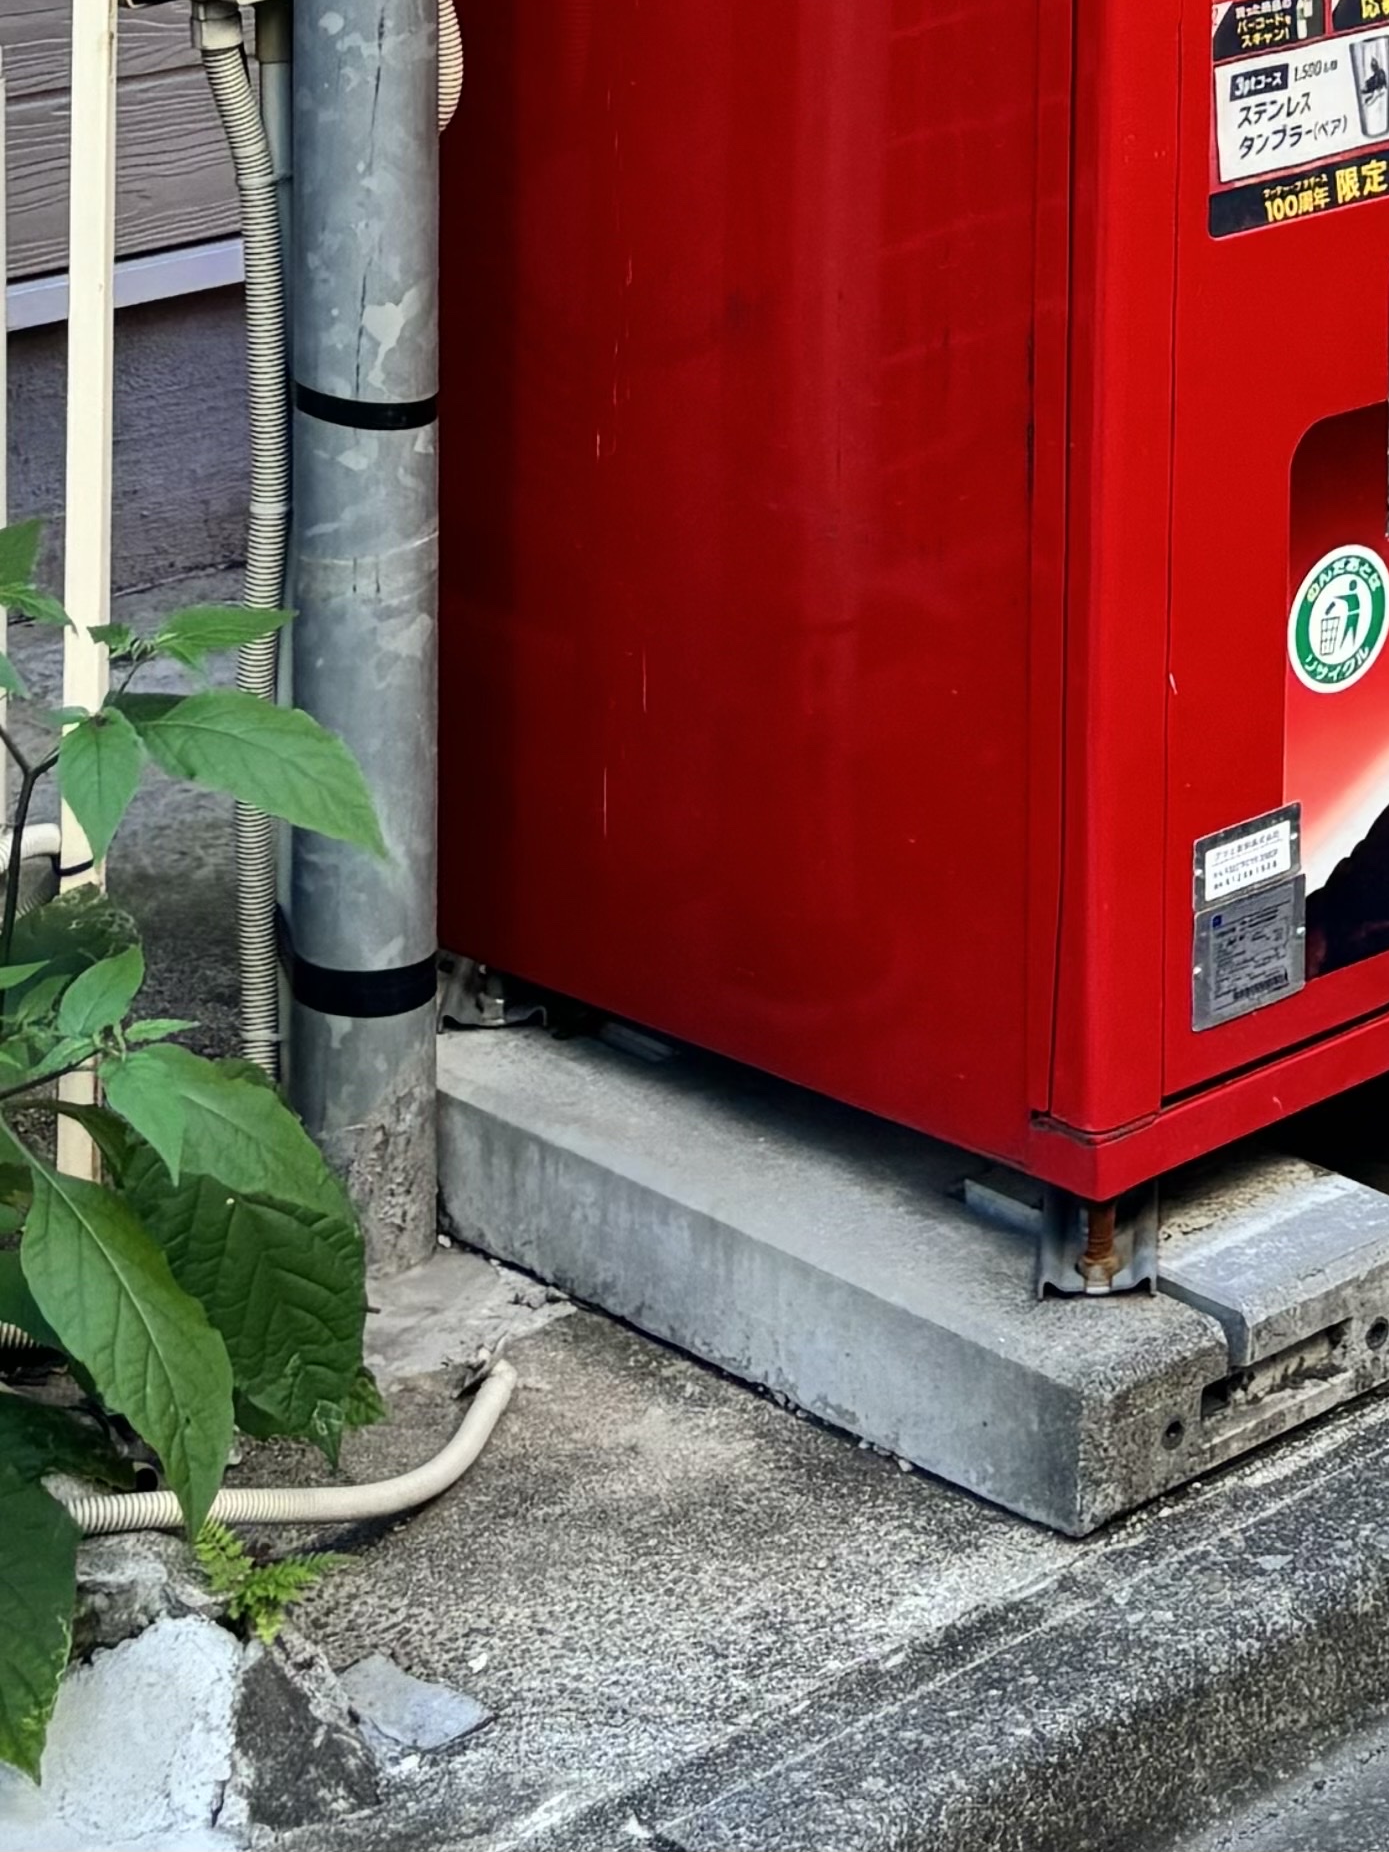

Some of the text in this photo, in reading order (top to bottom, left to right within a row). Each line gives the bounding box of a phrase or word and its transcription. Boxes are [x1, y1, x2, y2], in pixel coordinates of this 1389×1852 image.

[1237, 92, 1312, 130] ステンレス
[1239, 115, 1349, 161] タンブラー(ペア)
[1264, 187, 1331, 223] 100周年
[1306, 556, 1381, 603] のんだあとは
[1304, 646, 1370, 683] リサイクル
